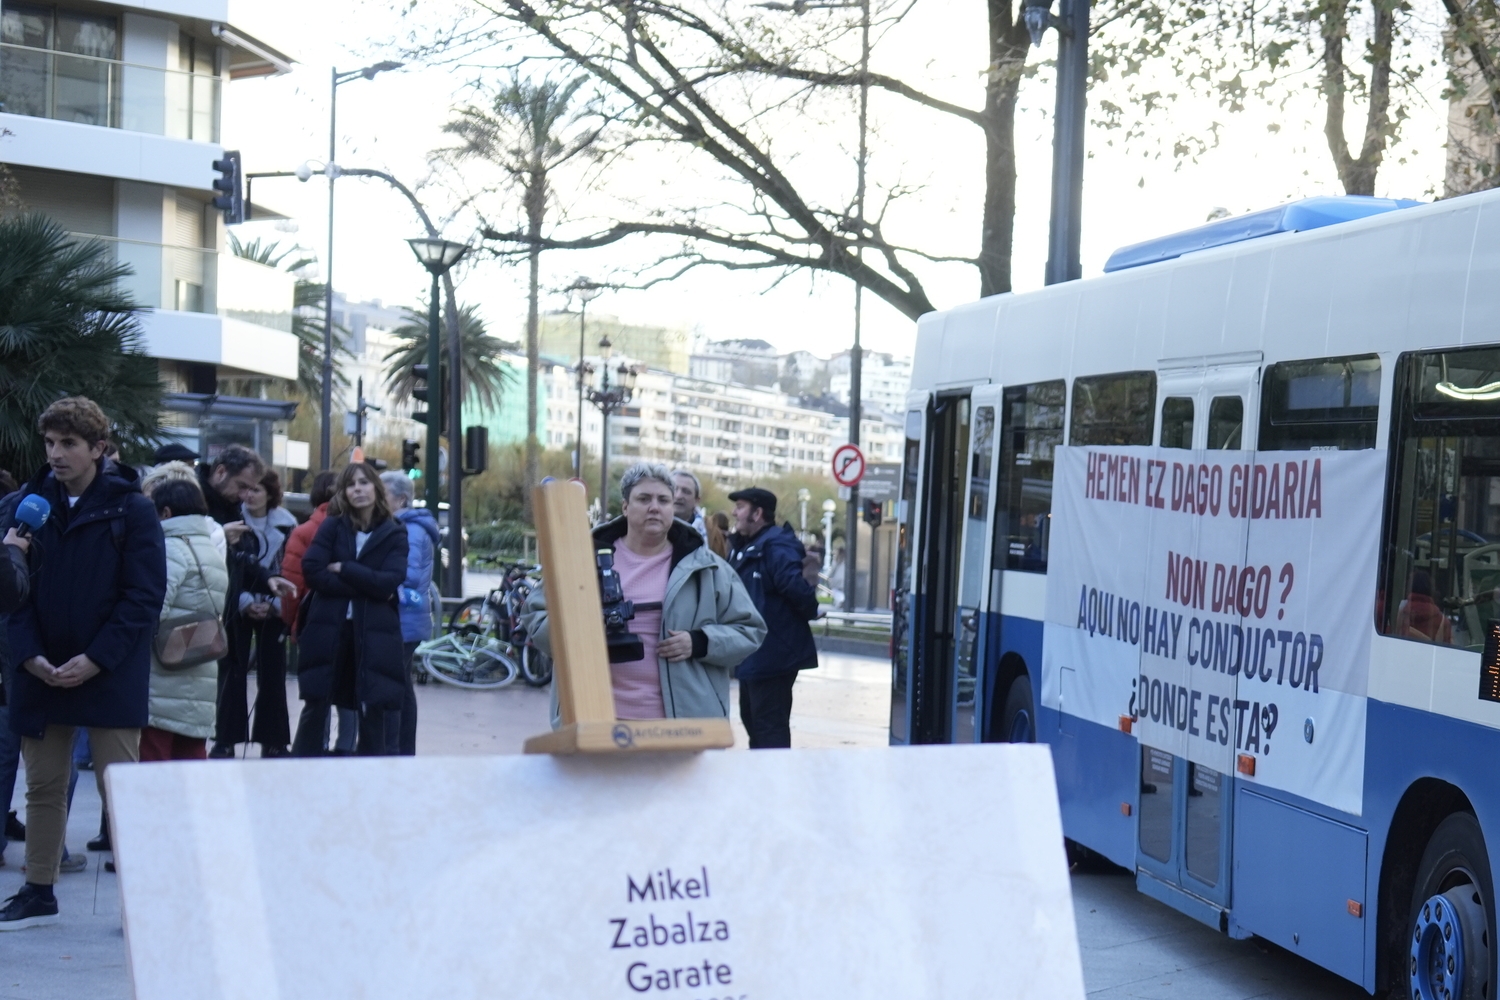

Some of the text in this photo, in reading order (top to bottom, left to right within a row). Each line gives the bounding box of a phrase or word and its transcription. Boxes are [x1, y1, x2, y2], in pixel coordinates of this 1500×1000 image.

[1085, 452, 1321, 519] HEMEN EZ DAGO GIDARIA
[1165, 551, 1208, 610] NON
[1211, 563, 1271, 619] DAGO
[1077, 584, 1323, 693] AQUI NO HAY CONDUCTOR
[1128, 674, 1201, 735] ¿DONDE
[627, 865, 710, 902] Mikel
[609, 911, 729, 948] Zabalza
[626, 959, 732, 992] Garate
